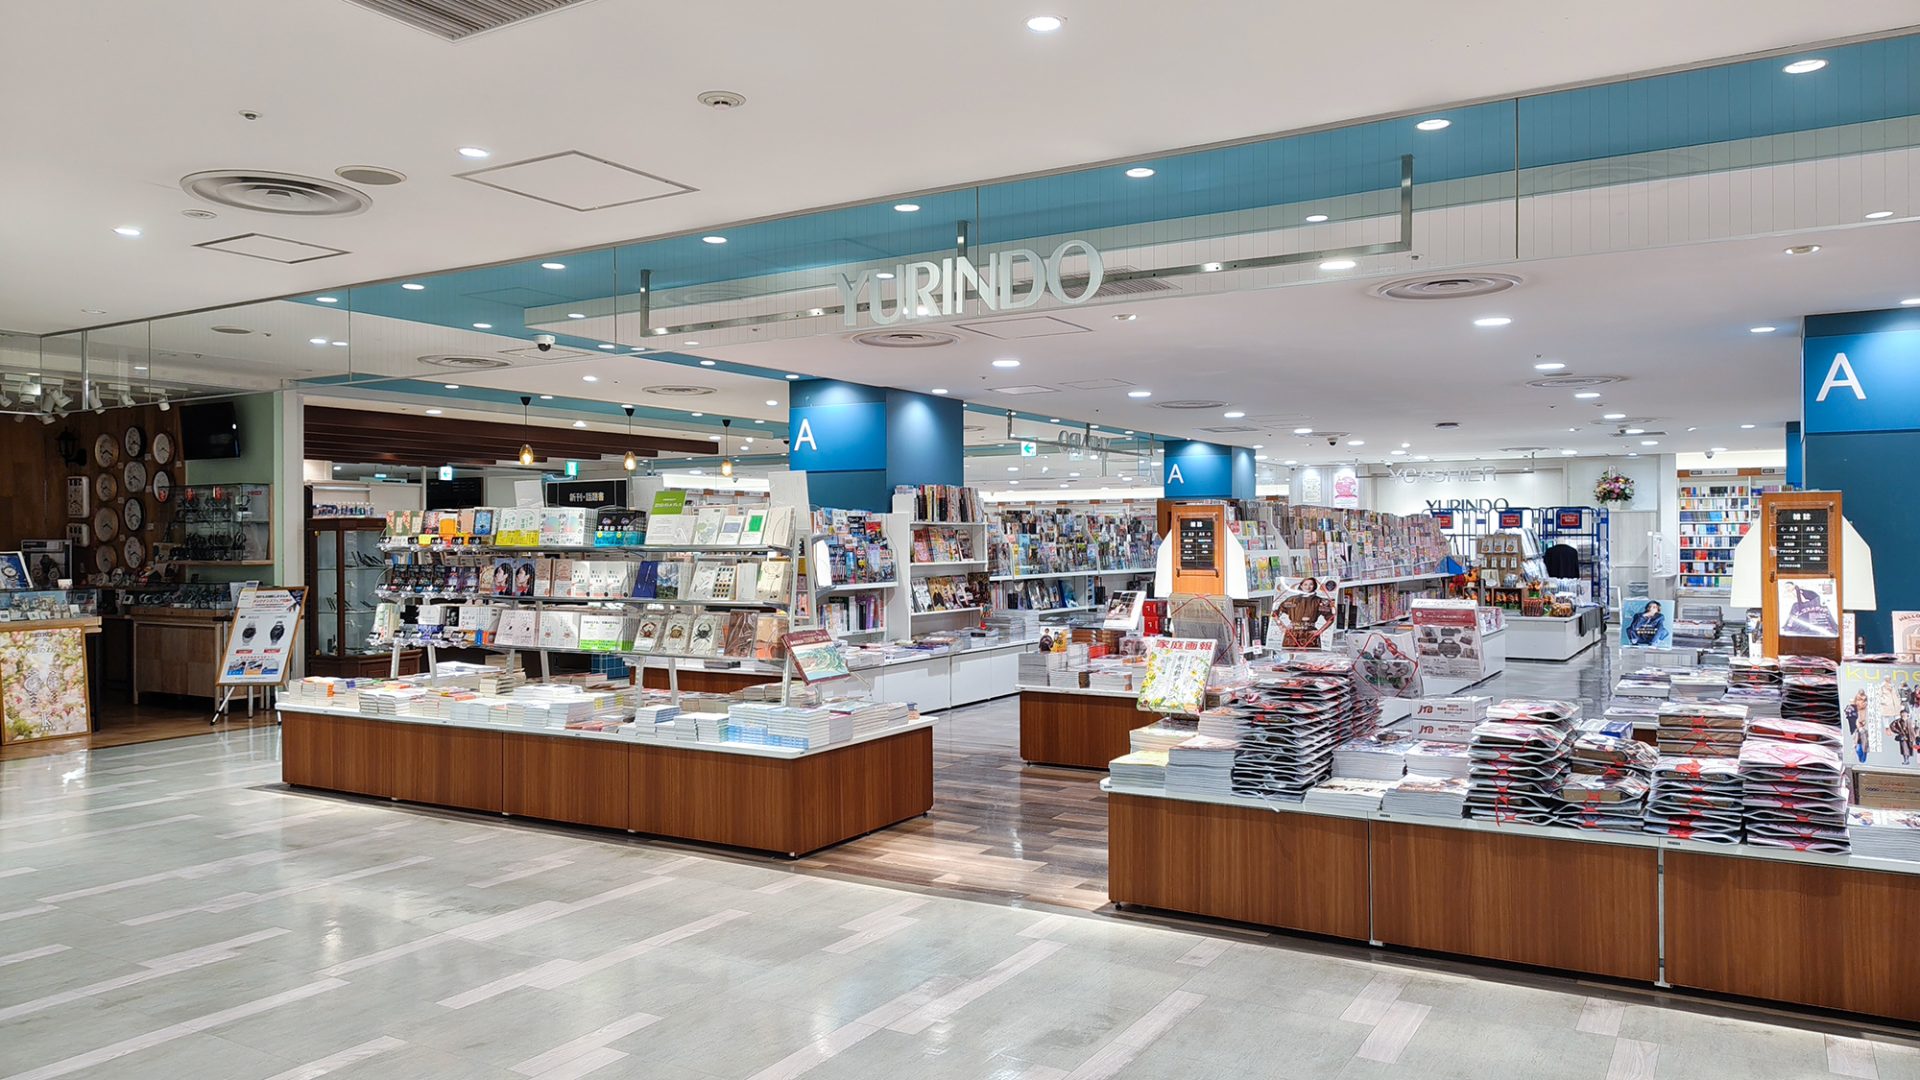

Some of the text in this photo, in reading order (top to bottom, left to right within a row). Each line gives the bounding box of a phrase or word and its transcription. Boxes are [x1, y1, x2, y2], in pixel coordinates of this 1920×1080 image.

[836, 239, 1104, 327] YURINDO
[1815, 352, 1867, 402] A
[793, 418, 817, 451] A
[1167, 463, 1184, 484] A
[1426, 497, 1509, 515] YURINDO
[1155, 639, 1213, 651] 家庭画報
[1417, 704, 1434, 715] JTB
[1418, 724, 1435, 735] JTB
